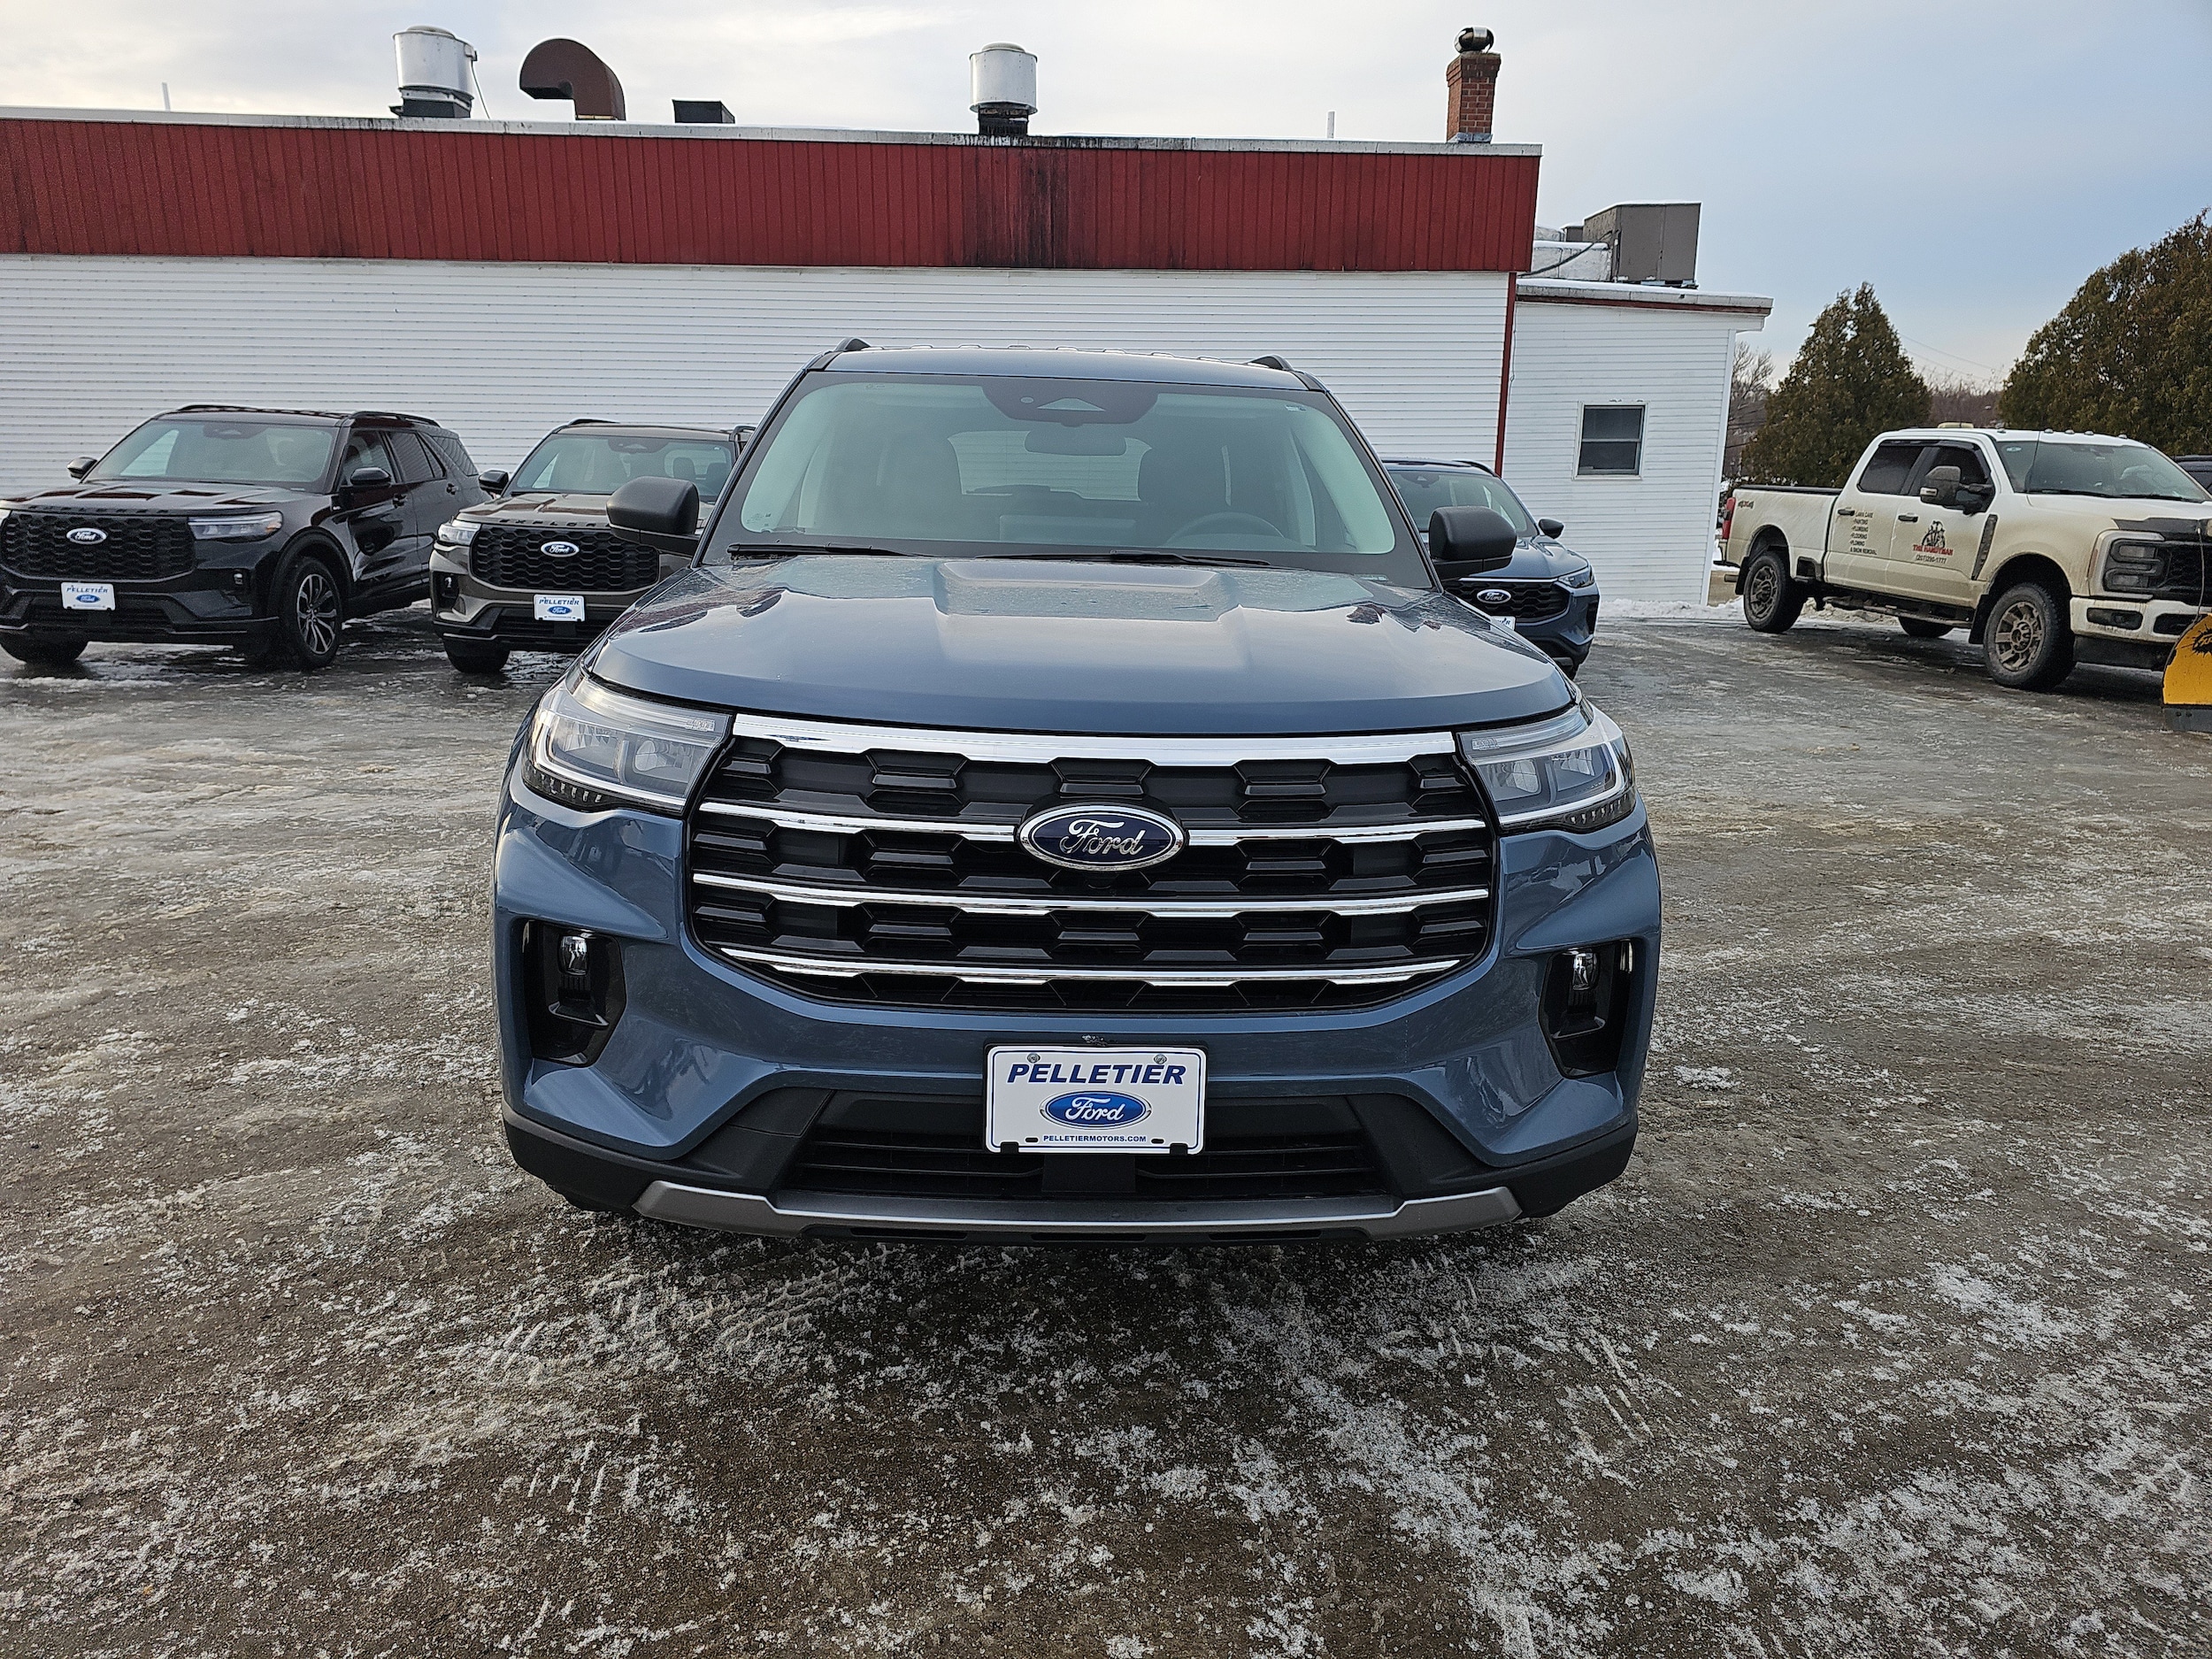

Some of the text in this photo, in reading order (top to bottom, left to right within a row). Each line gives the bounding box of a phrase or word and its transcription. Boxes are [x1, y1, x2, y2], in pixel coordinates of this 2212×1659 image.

[499, 518, 611, 527] EXPLOR
[74, 531, 96, 541] Ford
[549, 544, 571, 554] Ford
[1485, 592, 1503, 601] Ford
[1059, 818, 1146, 856] Ford
[1006, 1064, 1187, 1085] PELLETIER
[1064, 1096, 1125, 1121] Ford
